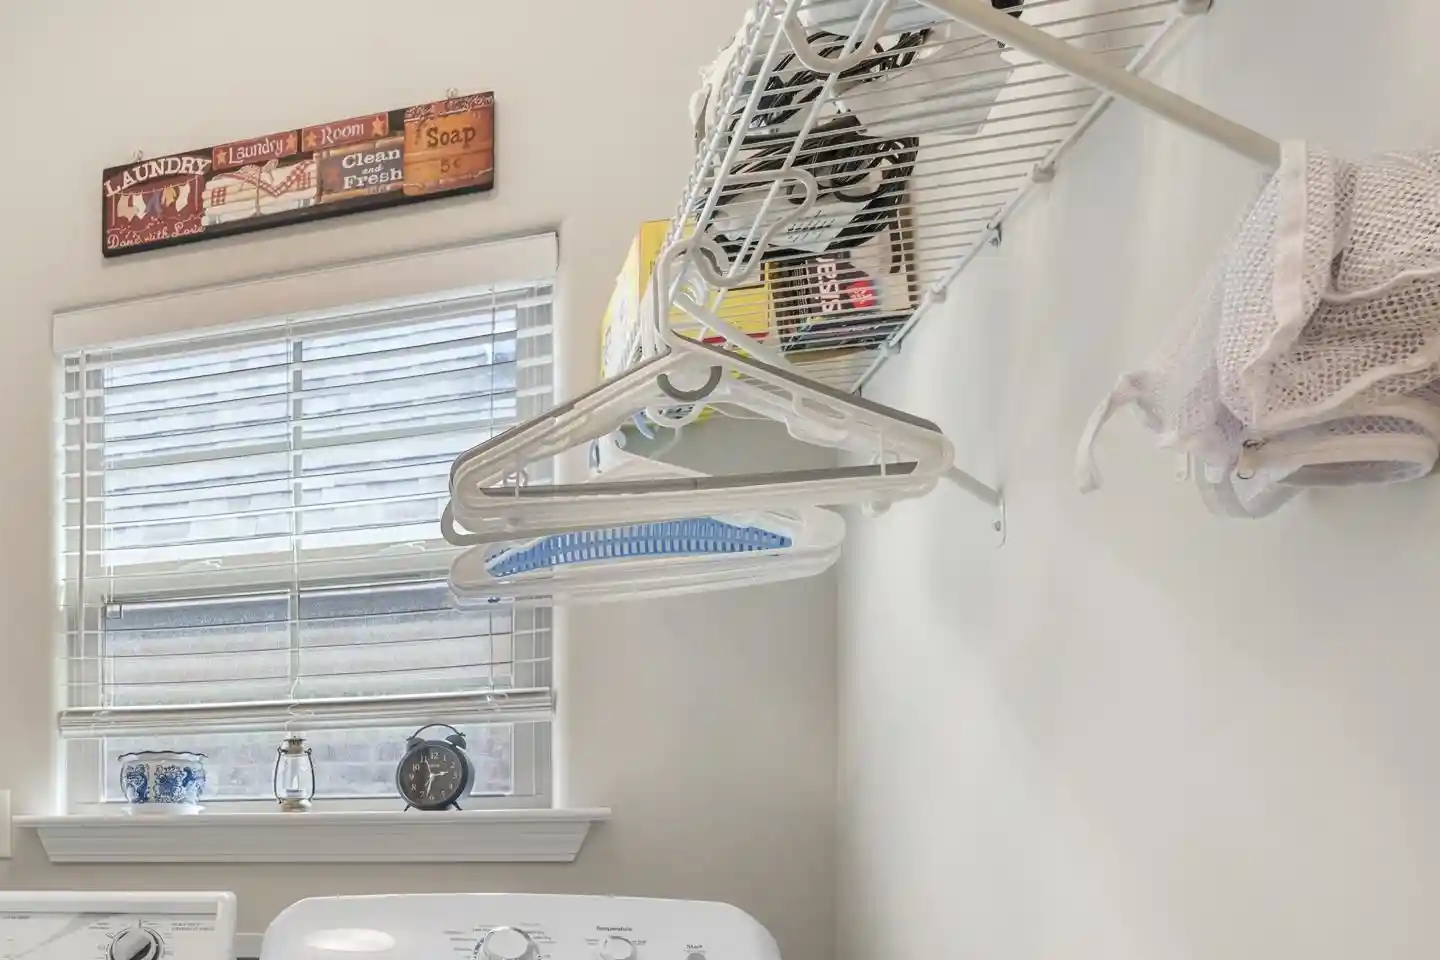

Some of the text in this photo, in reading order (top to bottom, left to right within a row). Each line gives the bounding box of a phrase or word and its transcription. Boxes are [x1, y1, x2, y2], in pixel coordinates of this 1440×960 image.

[229, 123, 364, 165] Laundry Room
[426, 126, 476, 149] Soap
[342, 148, 401, 169] Clean
[361, 163, 384, 175] and
[103, 156, 212, 197] LAUNDRY
[343, 167, 403, 190] Fresh
